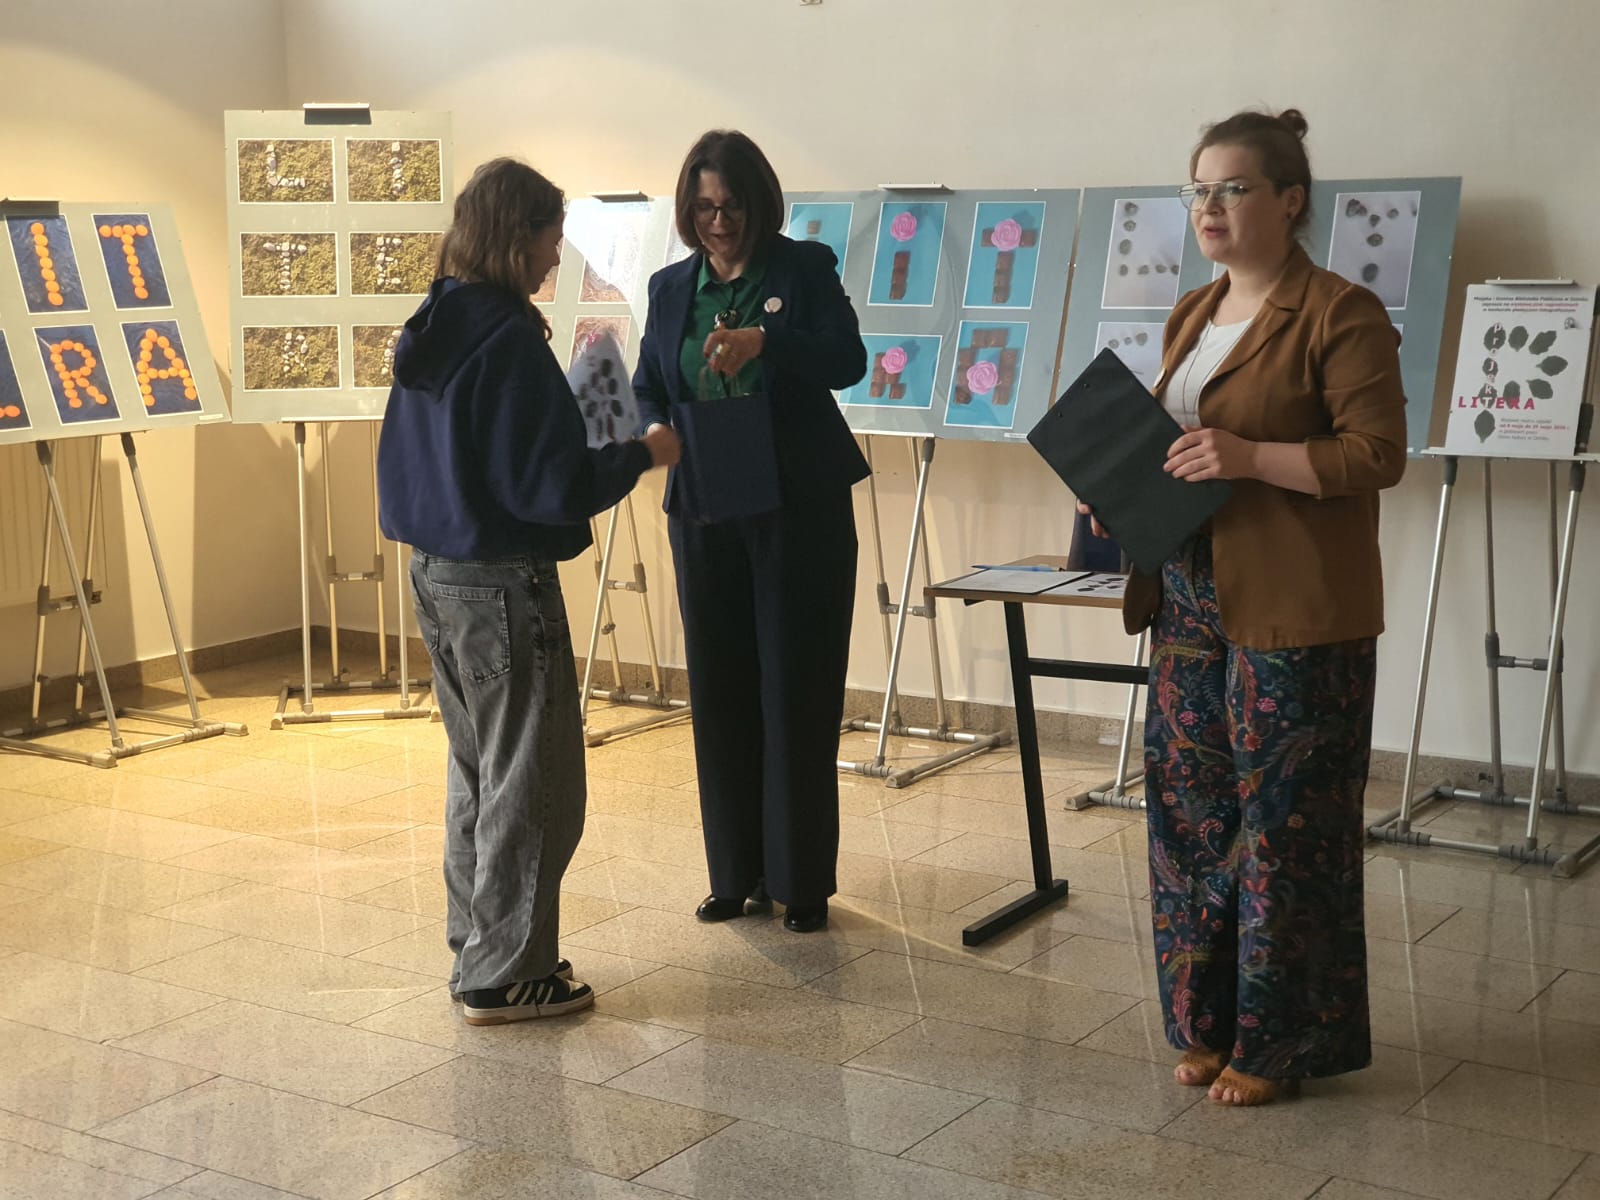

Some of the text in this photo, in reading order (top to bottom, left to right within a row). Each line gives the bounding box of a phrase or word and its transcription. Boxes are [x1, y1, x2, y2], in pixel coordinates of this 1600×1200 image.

[266, 143, 307, 188] L
[30, 221, 149, 307] I T
[262, 241, 308, 291] T
[50, 327, 198, 409] R A
[1457, 396, 1536, 411] LITERA
